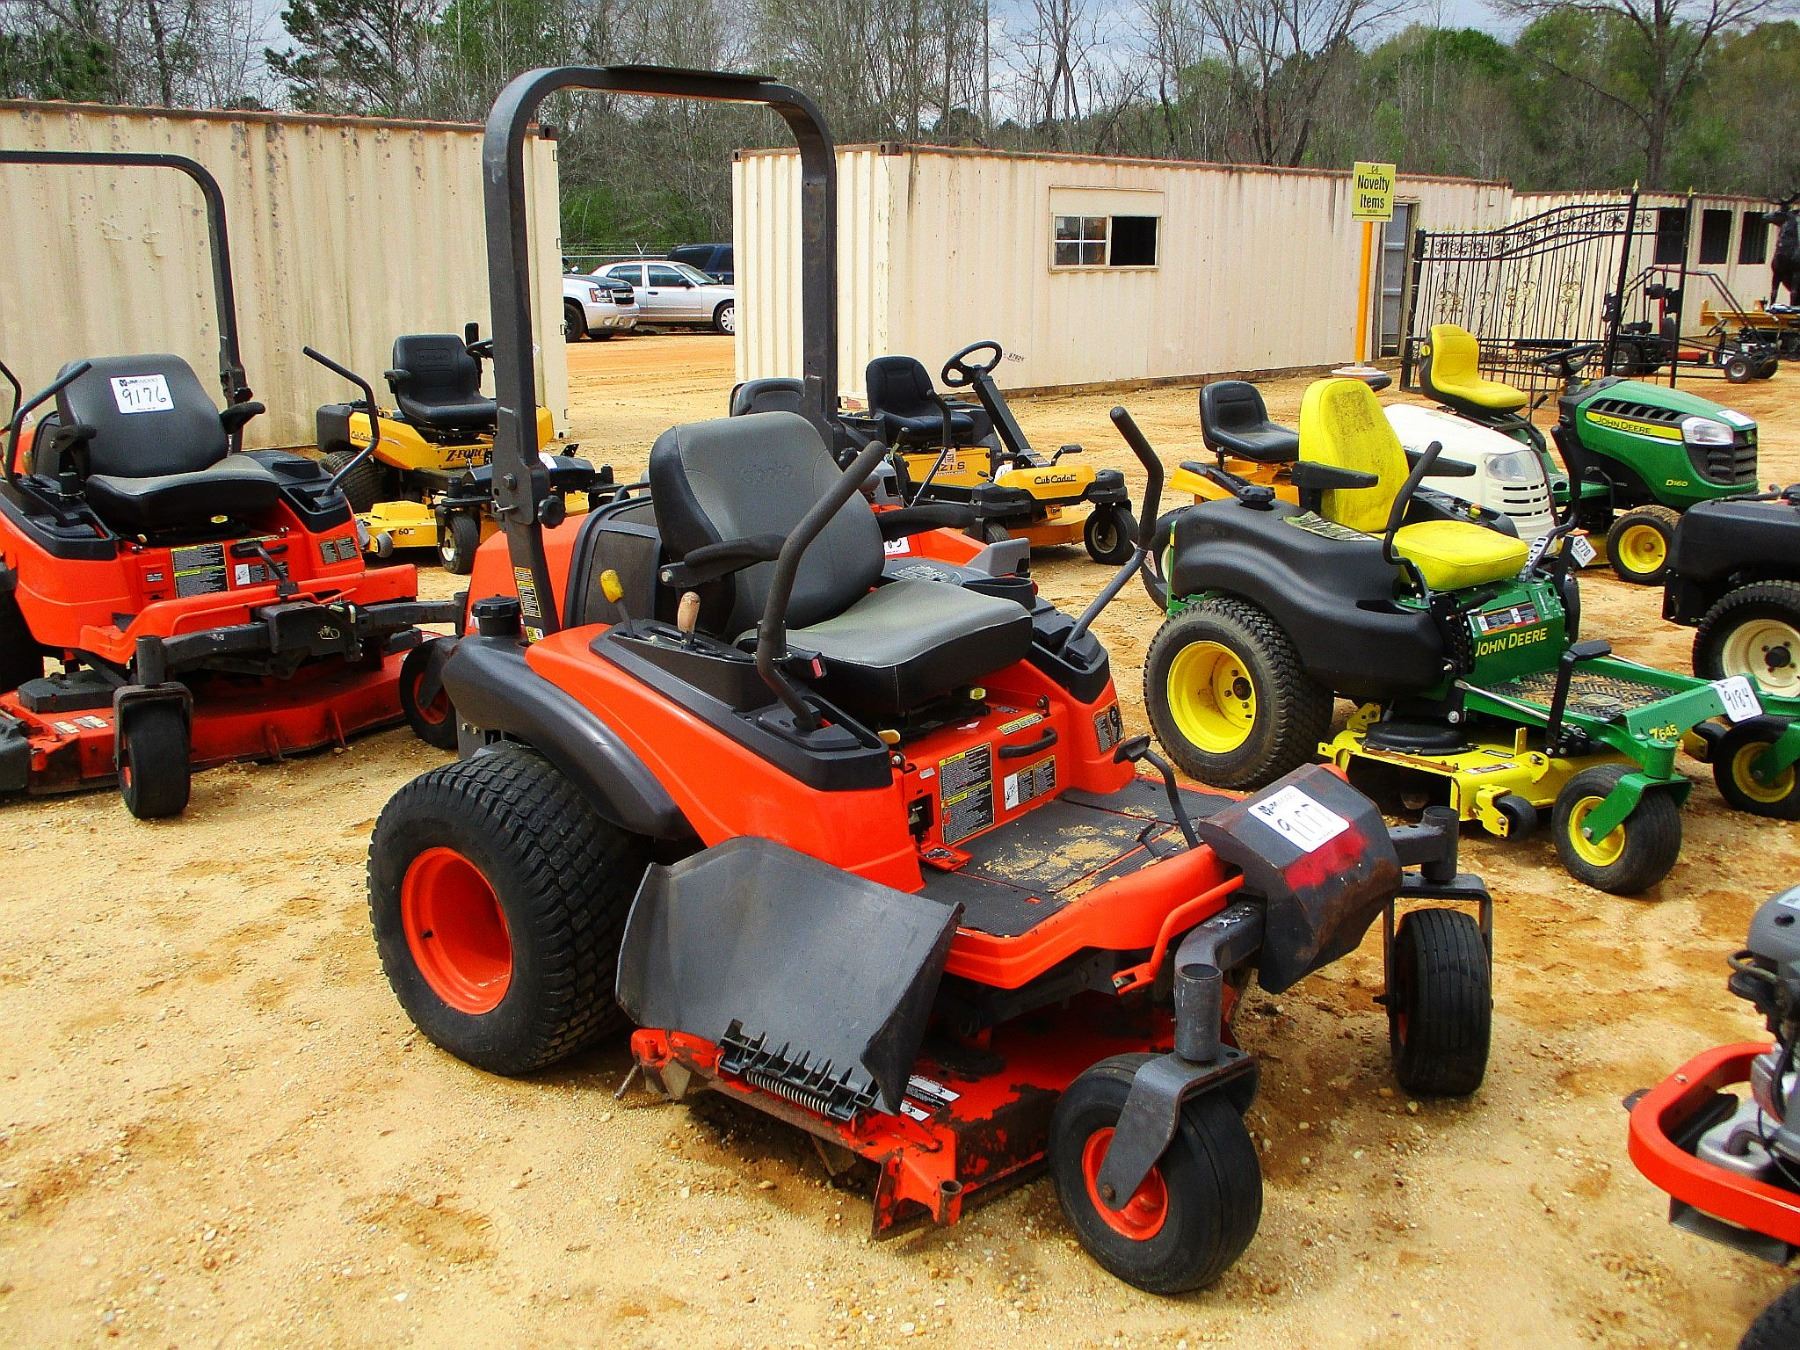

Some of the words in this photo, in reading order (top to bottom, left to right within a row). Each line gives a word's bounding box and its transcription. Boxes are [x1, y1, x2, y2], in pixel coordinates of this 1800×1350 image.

[1357, 175, 1390, 193] Novelty
[1360, 194, 1385, 209] Items
[122, 385, 167, 406] 9176
[1597, 415, 1620, 429] JOHN
[1620, 420, 1652, 435] DEERE
[1034, 475, 1050, 485] Cub
[1050, 473, 1077, 484] Cadet
[1665, 478, 1688, 488] D160
[1475, 637, 1507, 658] JOHN
[1508, 627, 1548, 650] DEERE
